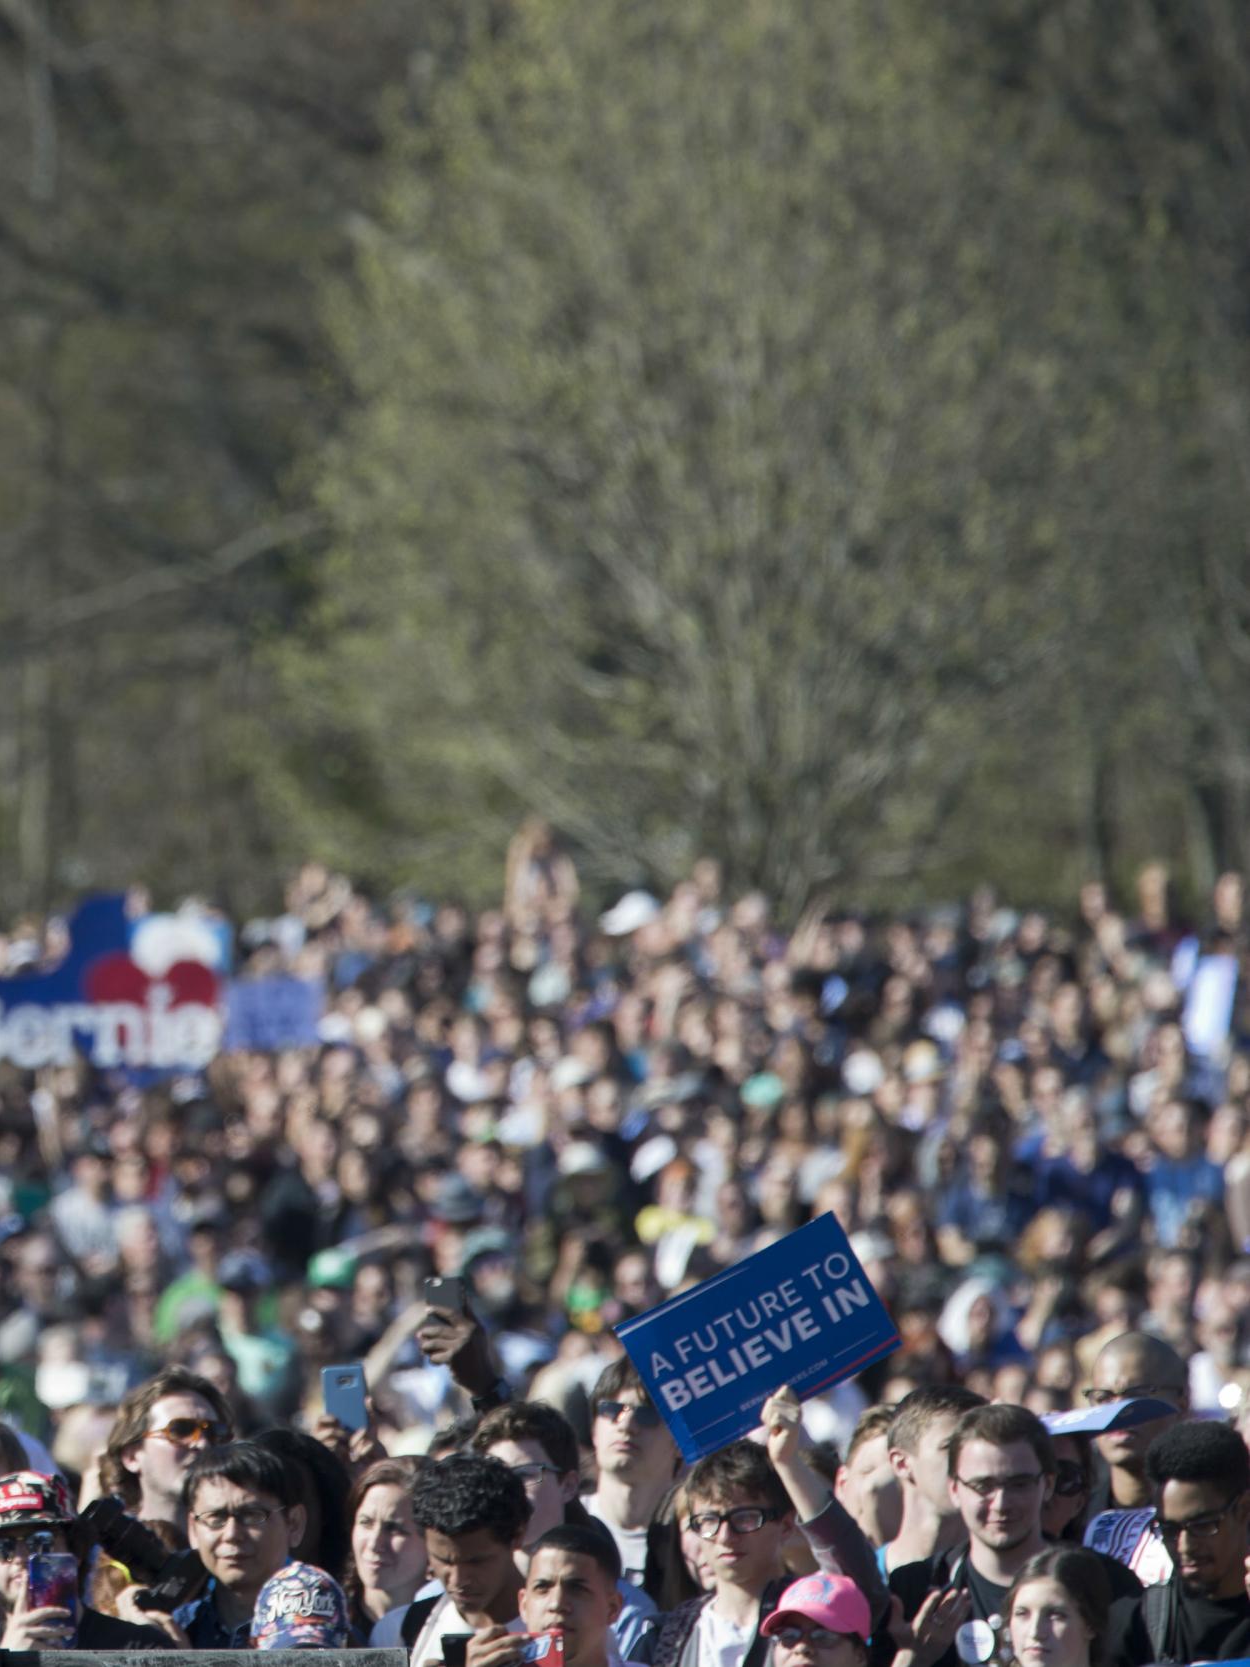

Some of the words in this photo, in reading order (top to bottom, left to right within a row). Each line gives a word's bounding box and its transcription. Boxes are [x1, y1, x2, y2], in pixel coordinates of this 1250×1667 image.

[651, 1352, 674, 1379] A
[673, 1279, 803, 1365] FUTURE
[802, 1252, 850, 1290] TO
[659, 1307, 821, 1412] BELIEVE
[820, 1279, 871, 1323] IN
[266, 1585, 301, 1622] New
[296, 1587, 336, 1616] York
